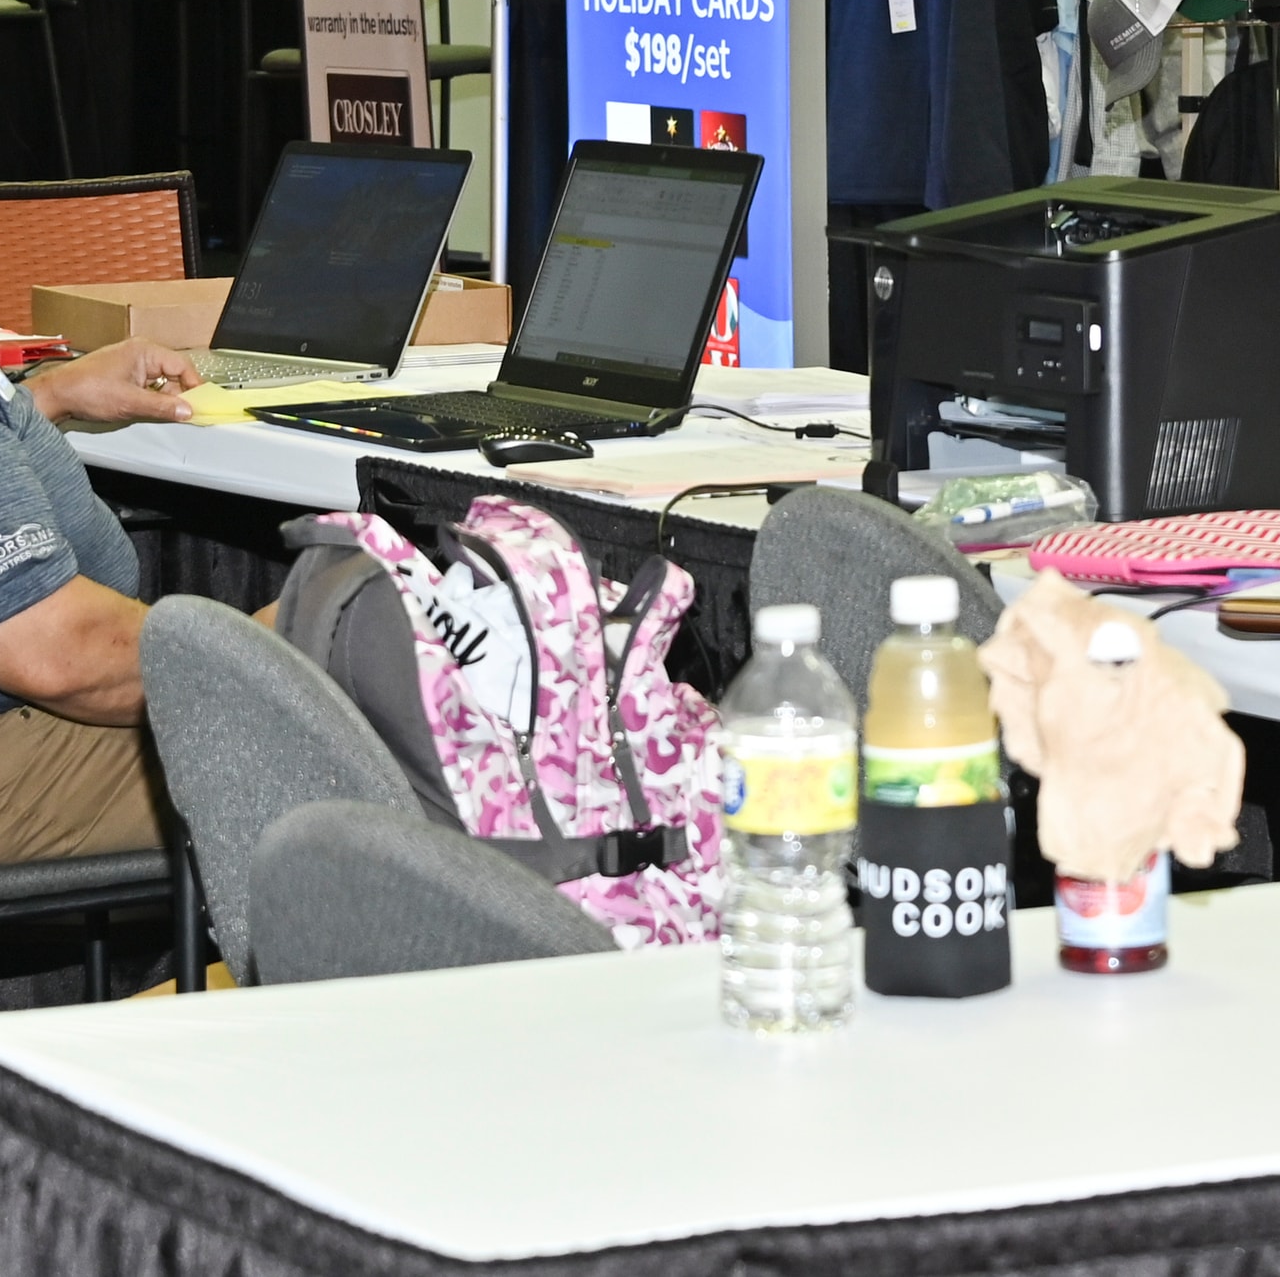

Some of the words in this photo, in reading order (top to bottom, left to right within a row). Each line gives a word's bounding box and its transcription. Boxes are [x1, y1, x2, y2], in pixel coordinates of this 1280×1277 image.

[308, 12, 347, 40] warranty
[360, 11, 377, 35] the
[378, 13, 420, 43] industry.
[625, 26, 731, 84] $198/set
[333, 98, 404, 137] CROSLEY
[892, 896, 1006, 939] COOK
